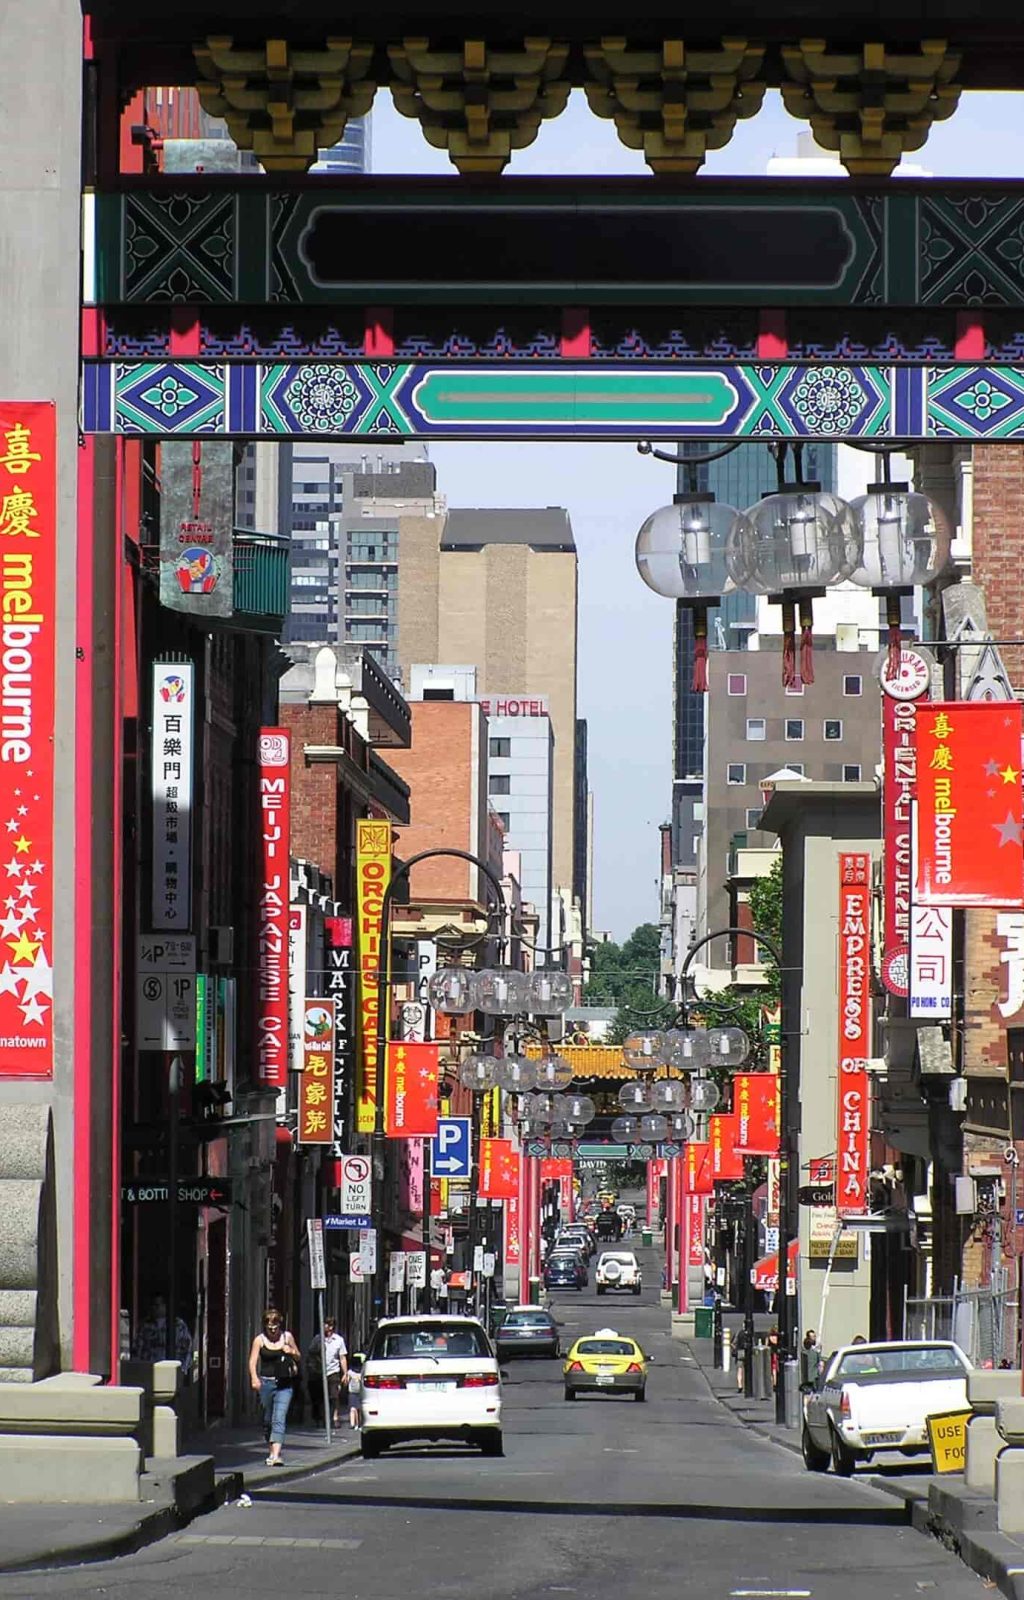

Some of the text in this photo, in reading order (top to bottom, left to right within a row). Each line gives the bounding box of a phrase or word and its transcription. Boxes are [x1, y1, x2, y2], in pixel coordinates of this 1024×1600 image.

[496, 700, 549, 717] HOTEL
[163, 714, 182, 780] 百樂門
[258, 778, 285, 1080] MEIJI JAPANESE CAFE
[361, 862, 385, 990] ORCHIDS
[915, 908, 949, 985] 公司
[174, 979, 191, 999] 1P
[329, 950, 349, 1031] MASK
[841, 894, 867, 1040] EMPRESS
[304, 1054, 328, 1134] 毛家菜
[841, 1058, 867, 1075] OF
[333, 1058, 345, 1157] CHINA
[439, 1125, 462, 1153] P
[842, 1091, 864, 1200] CHINA
[178, 1188, 208, 1201] SHOP
[346, 1203, 366, 1211] TURN
[348, 1185, 364, 1194] NO
[937, 1425, 961, 1439] USE
